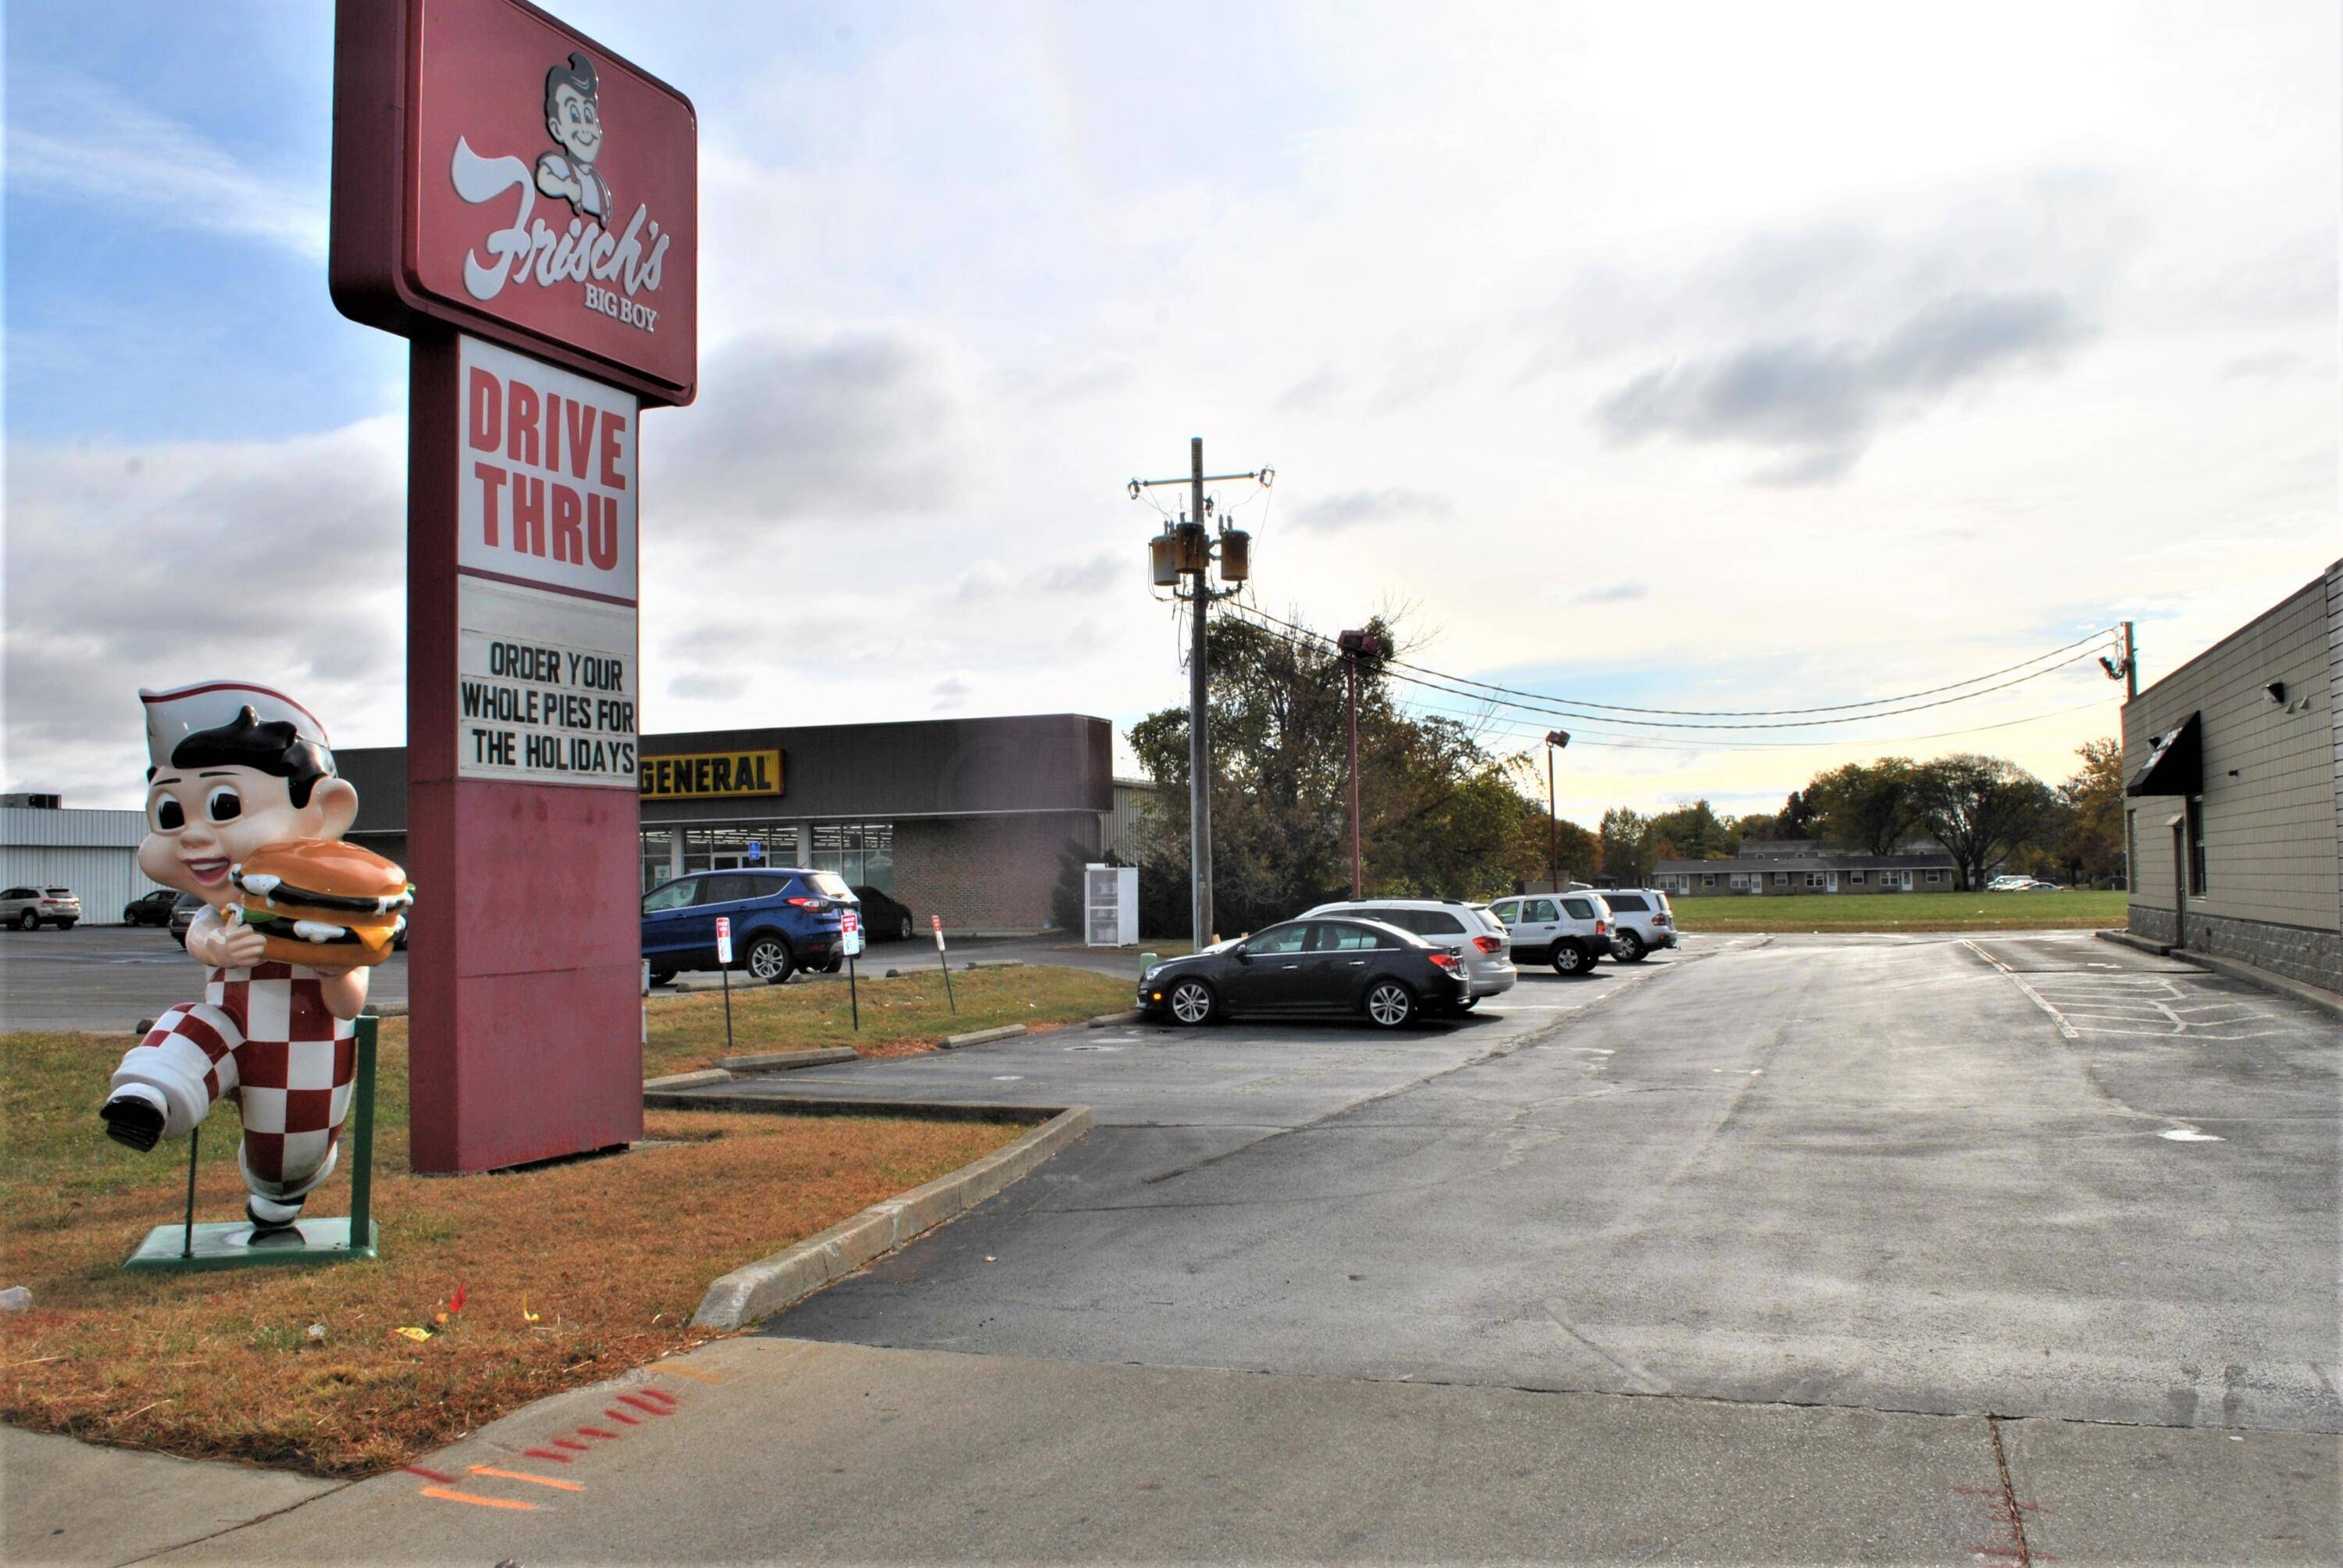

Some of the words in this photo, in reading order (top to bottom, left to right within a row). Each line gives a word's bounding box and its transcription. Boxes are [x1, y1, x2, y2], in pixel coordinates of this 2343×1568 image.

[451, 135, 669, 301] Frisch's
[584, 283, 618, 318] BIG
[619, 297, 658, 333] BOY
[469, 365, 626, 491] DRIVE
[474, 461, 619, 572] THRU
[490, 641, 561, 683] ORDER
[567, 651, 623, 692] YOUR
[462, 682, 539, 725] WHOLE
[544, 692, 592, 729] PIES
[597, 699, 634, 732] FOR
[472, 729, 516, 766] THE
[526, 734, 634, 774] HOLIDAYS
[640, 755, 772, 795] GENERAL
